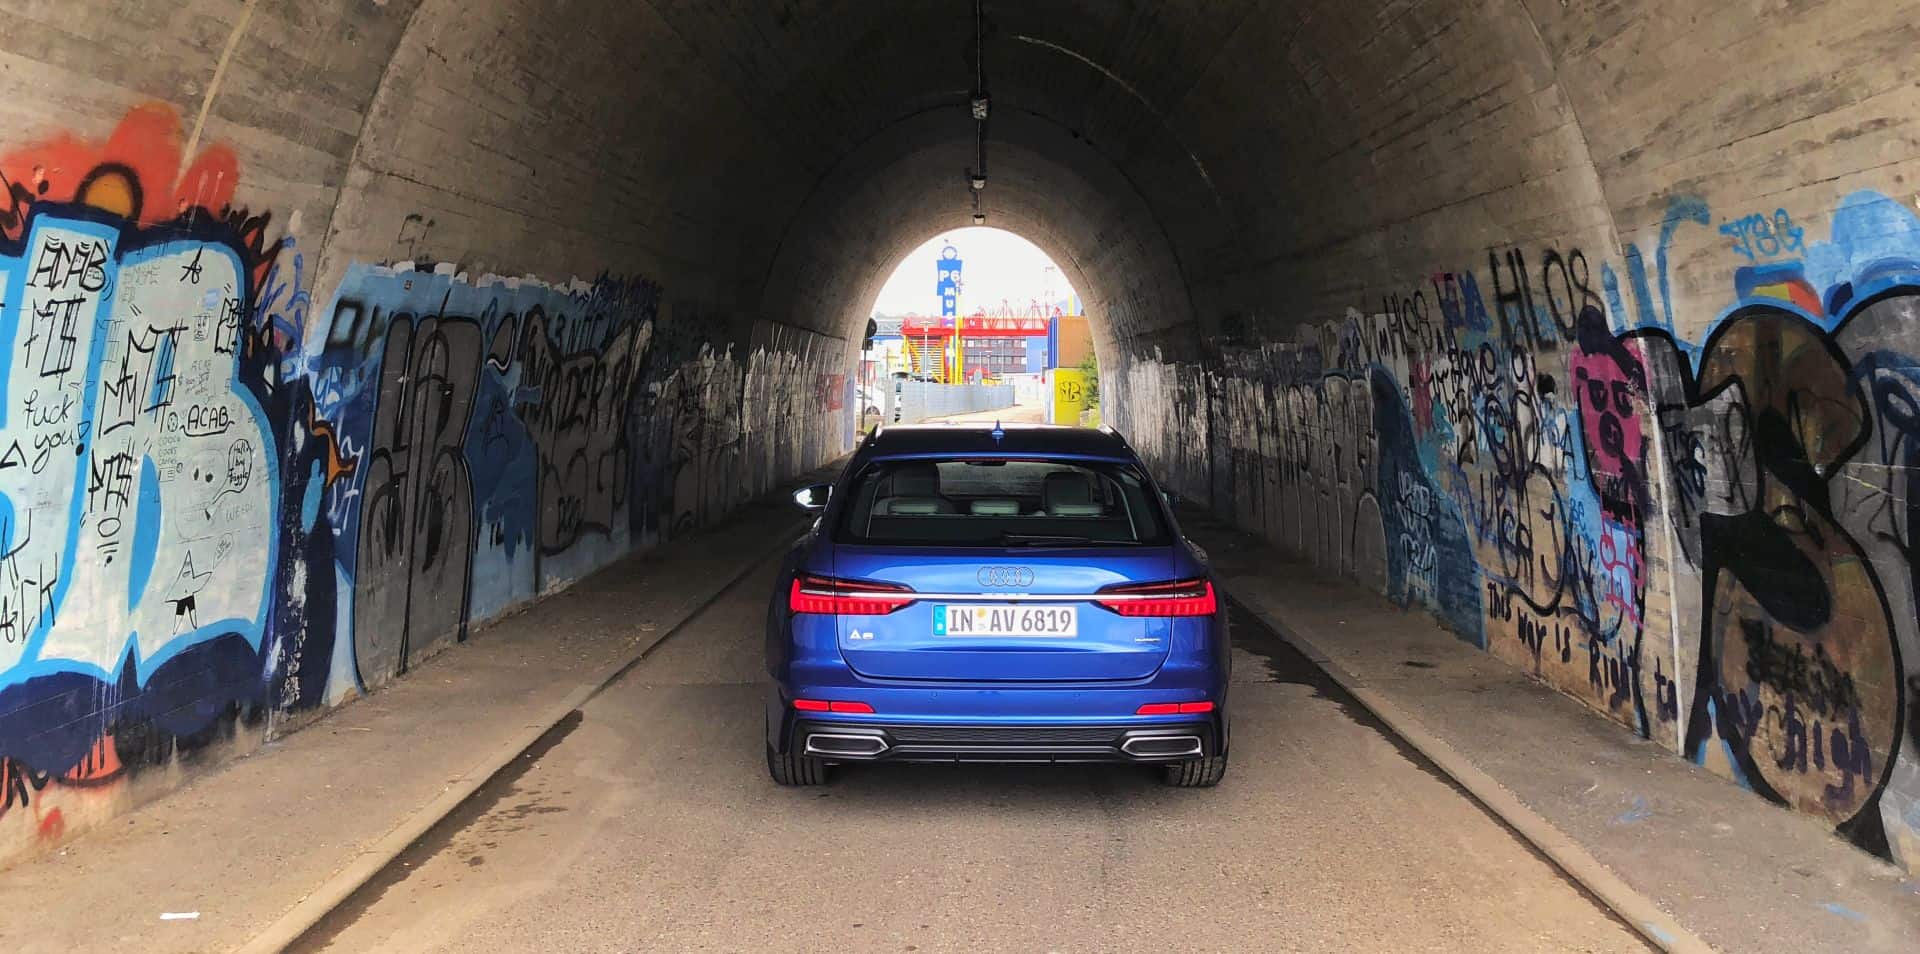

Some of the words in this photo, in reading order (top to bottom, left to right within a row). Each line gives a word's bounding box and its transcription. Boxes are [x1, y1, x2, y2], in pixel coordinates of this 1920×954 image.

[939, 270, 961, 282] P6
[187, 404, 230, 431] ACAB
[949, 609, 973, 632] IN
[990, 609, 1015, 632] AV
[1021, 609, 1072, 632] 6819
